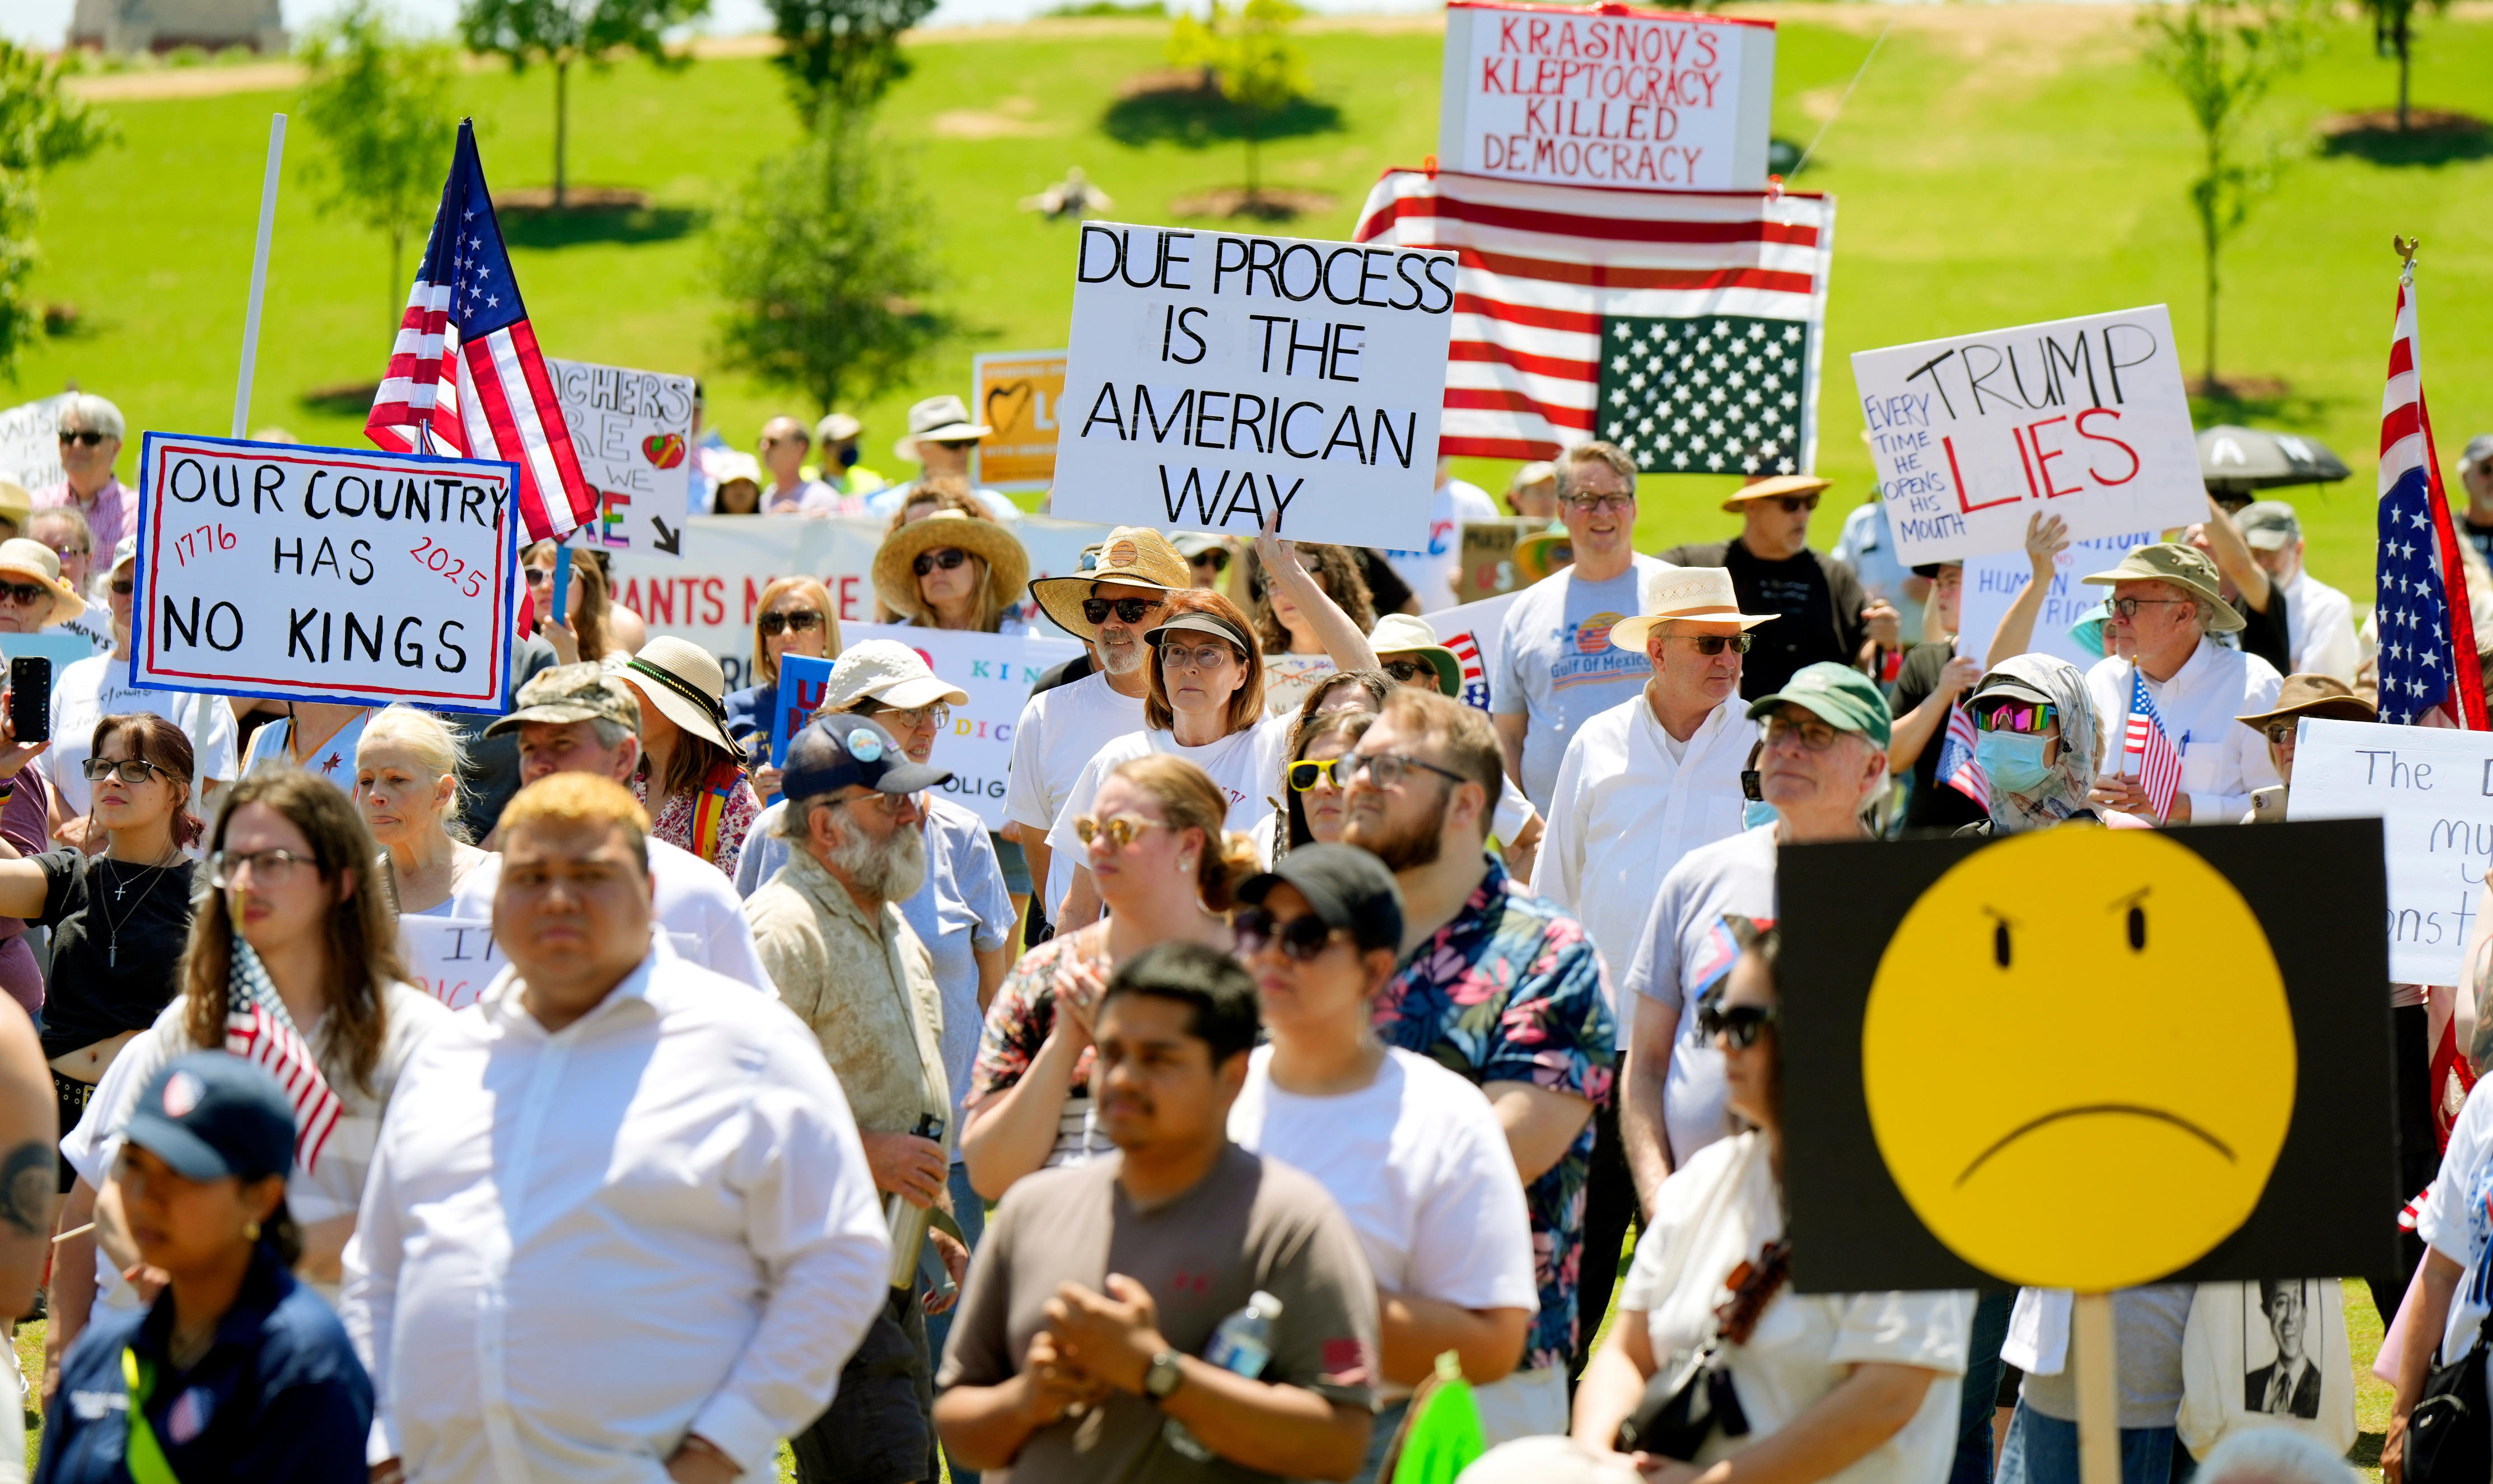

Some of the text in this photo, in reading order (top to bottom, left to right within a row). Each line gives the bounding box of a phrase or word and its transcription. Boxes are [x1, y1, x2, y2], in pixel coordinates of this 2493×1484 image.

[1499, 16, 1719, 70] KRASNOV'S
[1481, 58, 1721, 109] KLEPTOCRACY
[1524, 99, 1678, 142] KILLED
[1484, 134, 1702, 184] DEMOCRACY
[1078, 226, 1454, 314] DUE PROCESS
[1162, 305, 1365, 382] IS THE
[1906, 324, 2157, 420] TRUMP
[1081, 382, 1416, 468] AMERICAN
[1864, 393, 1930, 431] EVERY
[1874, 431, 1930, 454] TIME
[1894, 453, 1922, 474] HE
[1943, 407, 2140, 515] LIES
[171, 459, 509, 530] OUR COUNTRY
[606, 464, 654, 493] WE
[1159, 465, 1304, 533] WAY
[1884, 471, 1945, 501] OPENS
[1910, 494, 1941, 514] HIS
[1901, 512, 1966, 543] MOUTH
[175, 523, 487, 597] 1776 HAS 2025
[1476, 561, 1514, 592] US
[744, 575, 860, 625] ME
[1980, 568, 2068, 596] HUMN
[2046, 598, 2099, 625] RI
[164, 595, 467, 673] NO KINGS
[1551, 662, 1578, 678] Gulf
[1584, 656, 1599, 672] Of
[943, 776, 1005, 797] OLIG
[2355, 751, 2433, 790] The
